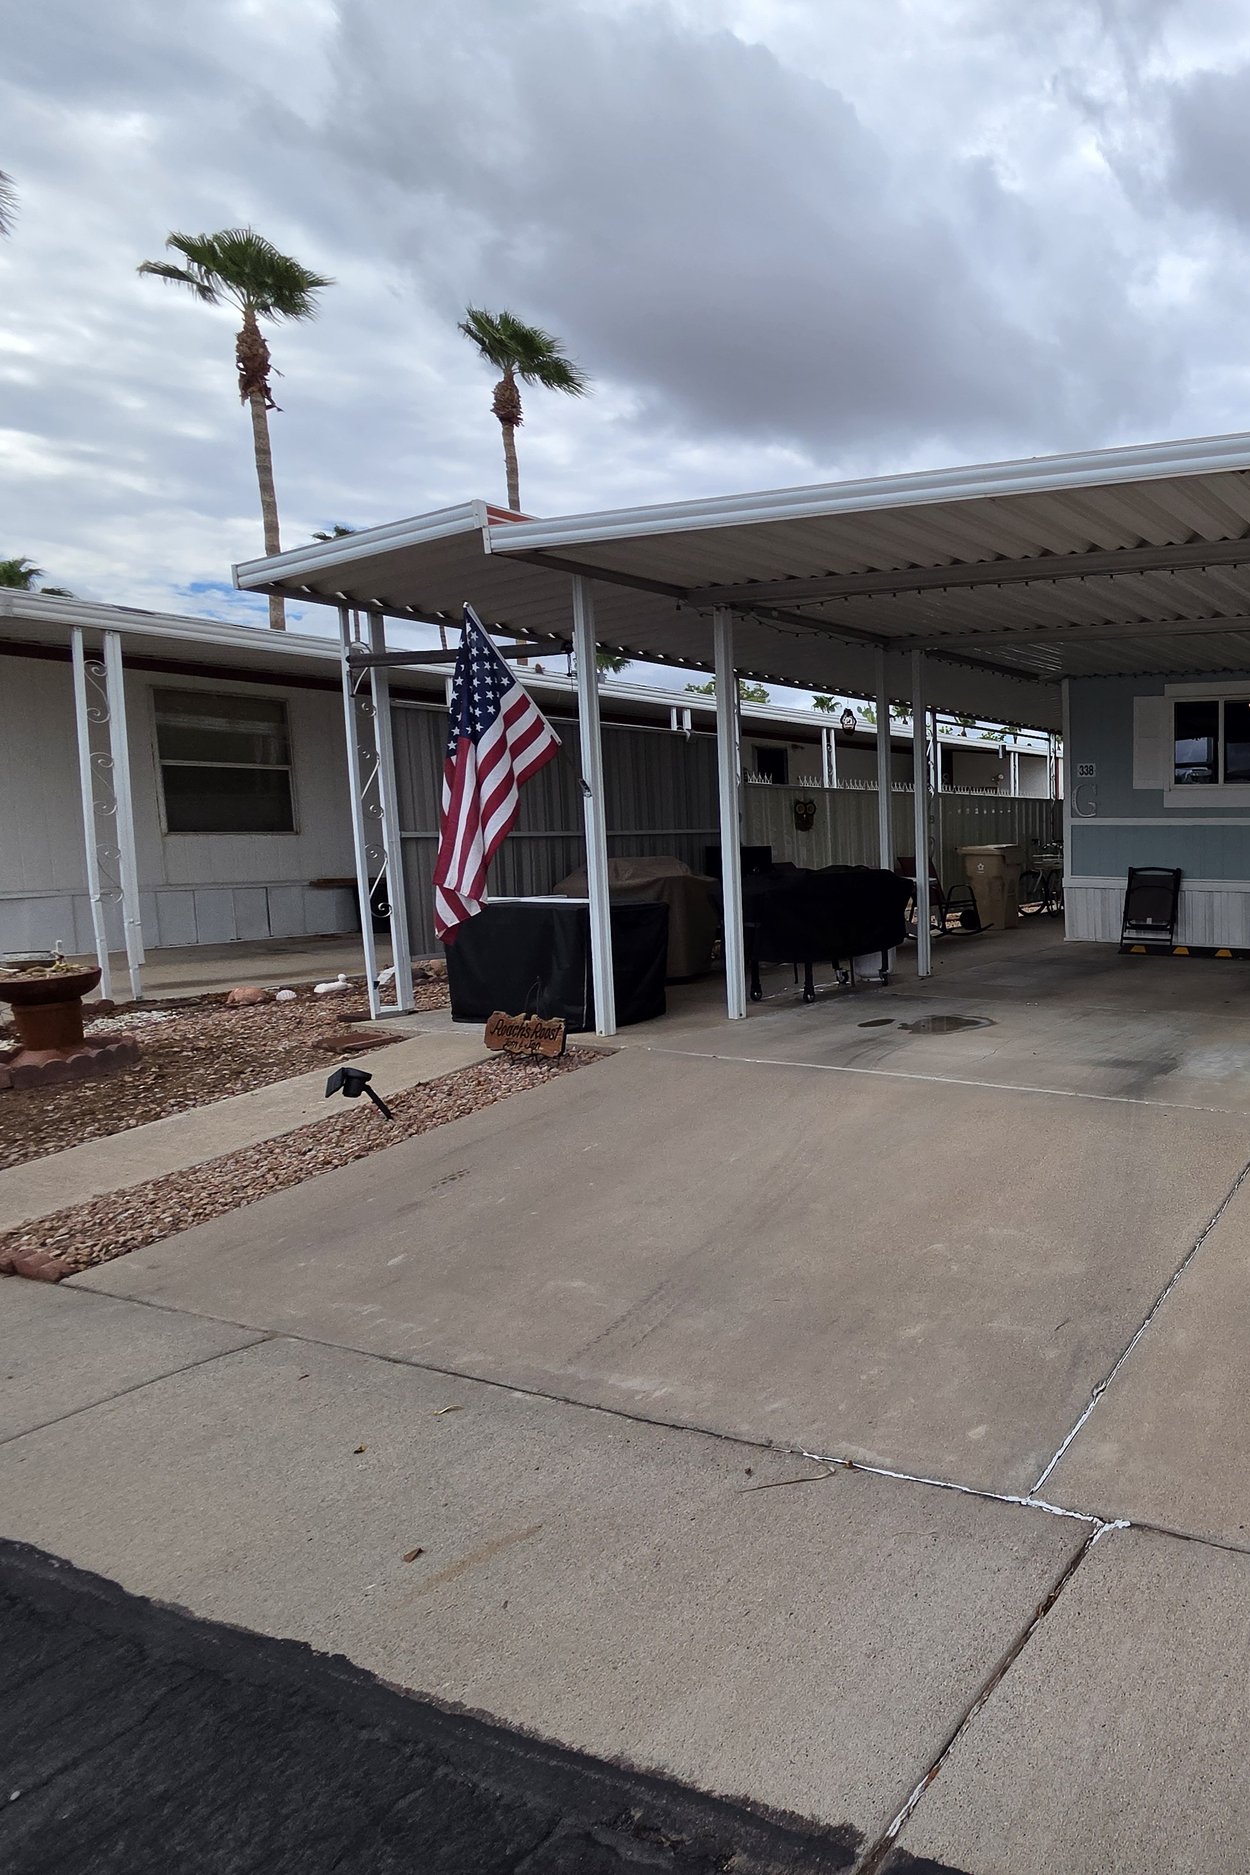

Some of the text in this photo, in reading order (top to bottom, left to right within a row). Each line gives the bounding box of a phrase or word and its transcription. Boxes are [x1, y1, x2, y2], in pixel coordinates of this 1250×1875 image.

[1079, 764, 1094, 776] 338
[490, 1019, 562, 1040] Roach's Roost
